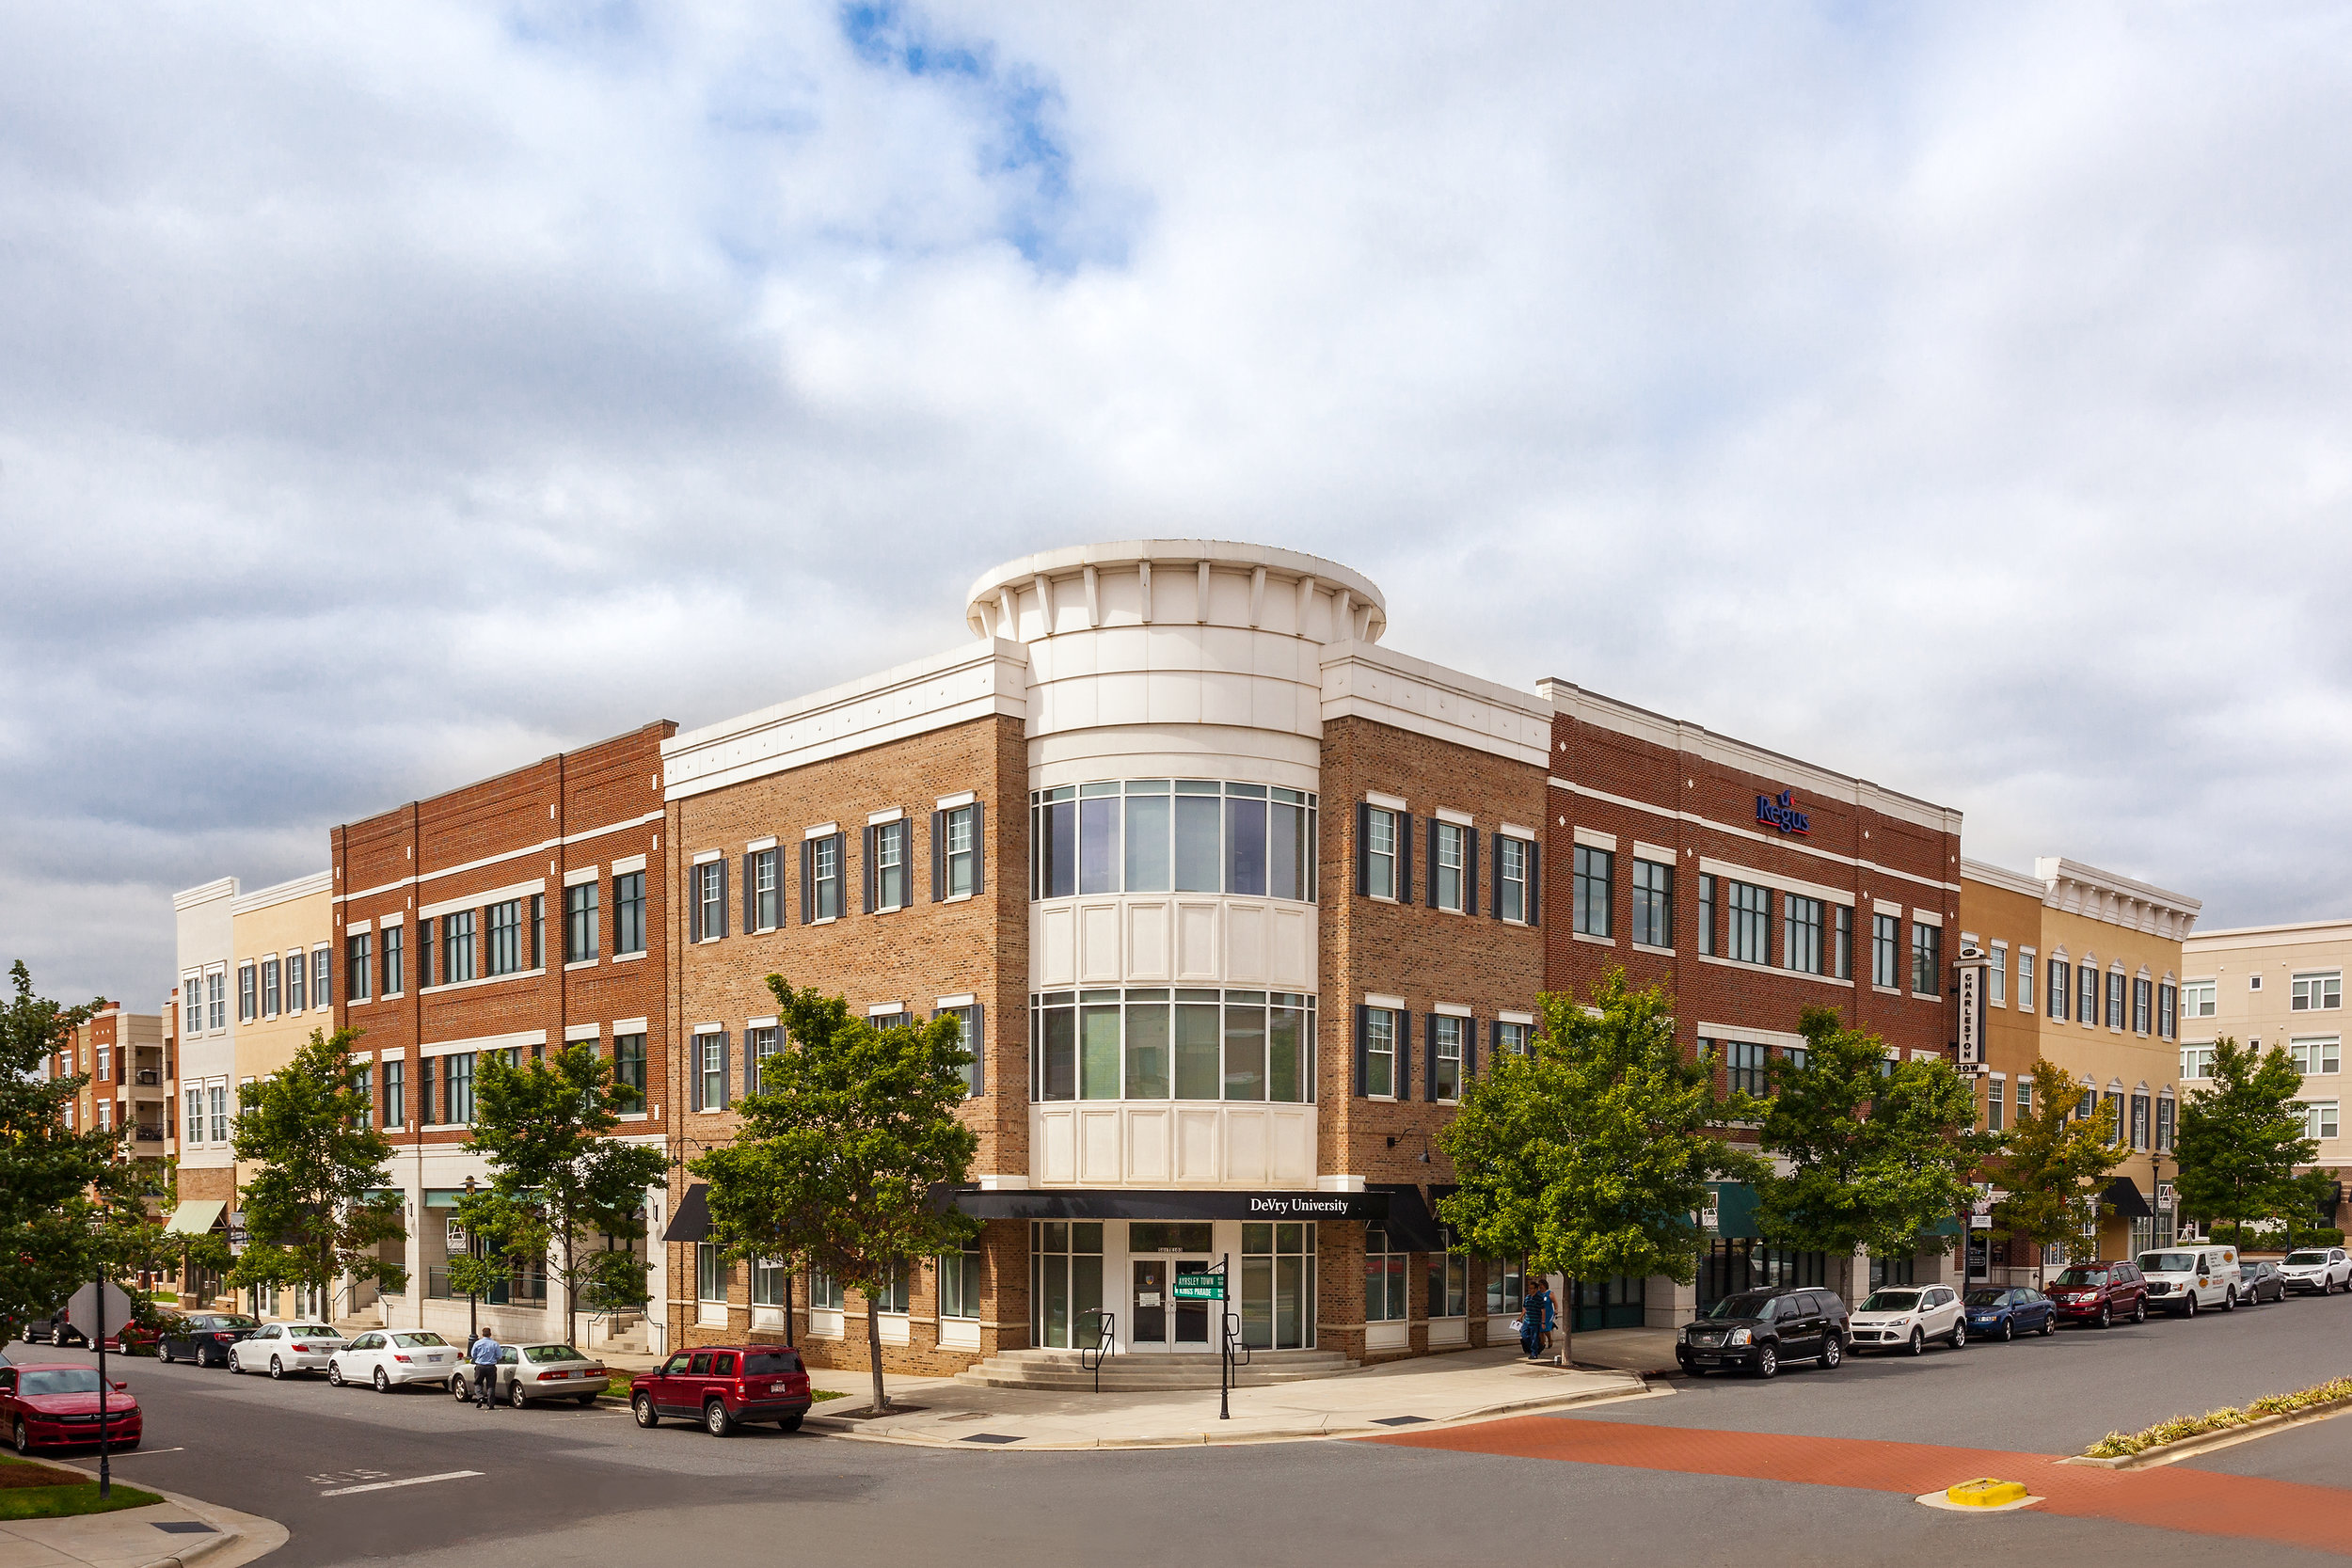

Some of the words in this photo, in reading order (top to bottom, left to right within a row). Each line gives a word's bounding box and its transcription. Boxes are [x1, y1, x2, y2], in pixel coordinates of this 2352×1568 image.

[1757, 796, 1810, 832] Regus
[1963, 974, 1972, 1059] CHARLESTON
[1250, 1198, 1289, 1214] DeVry
[1292, 1198, 1349, 1214] University
[1179, 1277, 1200, 1286] AYRSLEY
[1200, 1276, 1214, 1286] TOWN
[1195, 1288, 1212, 1297] PARADE
